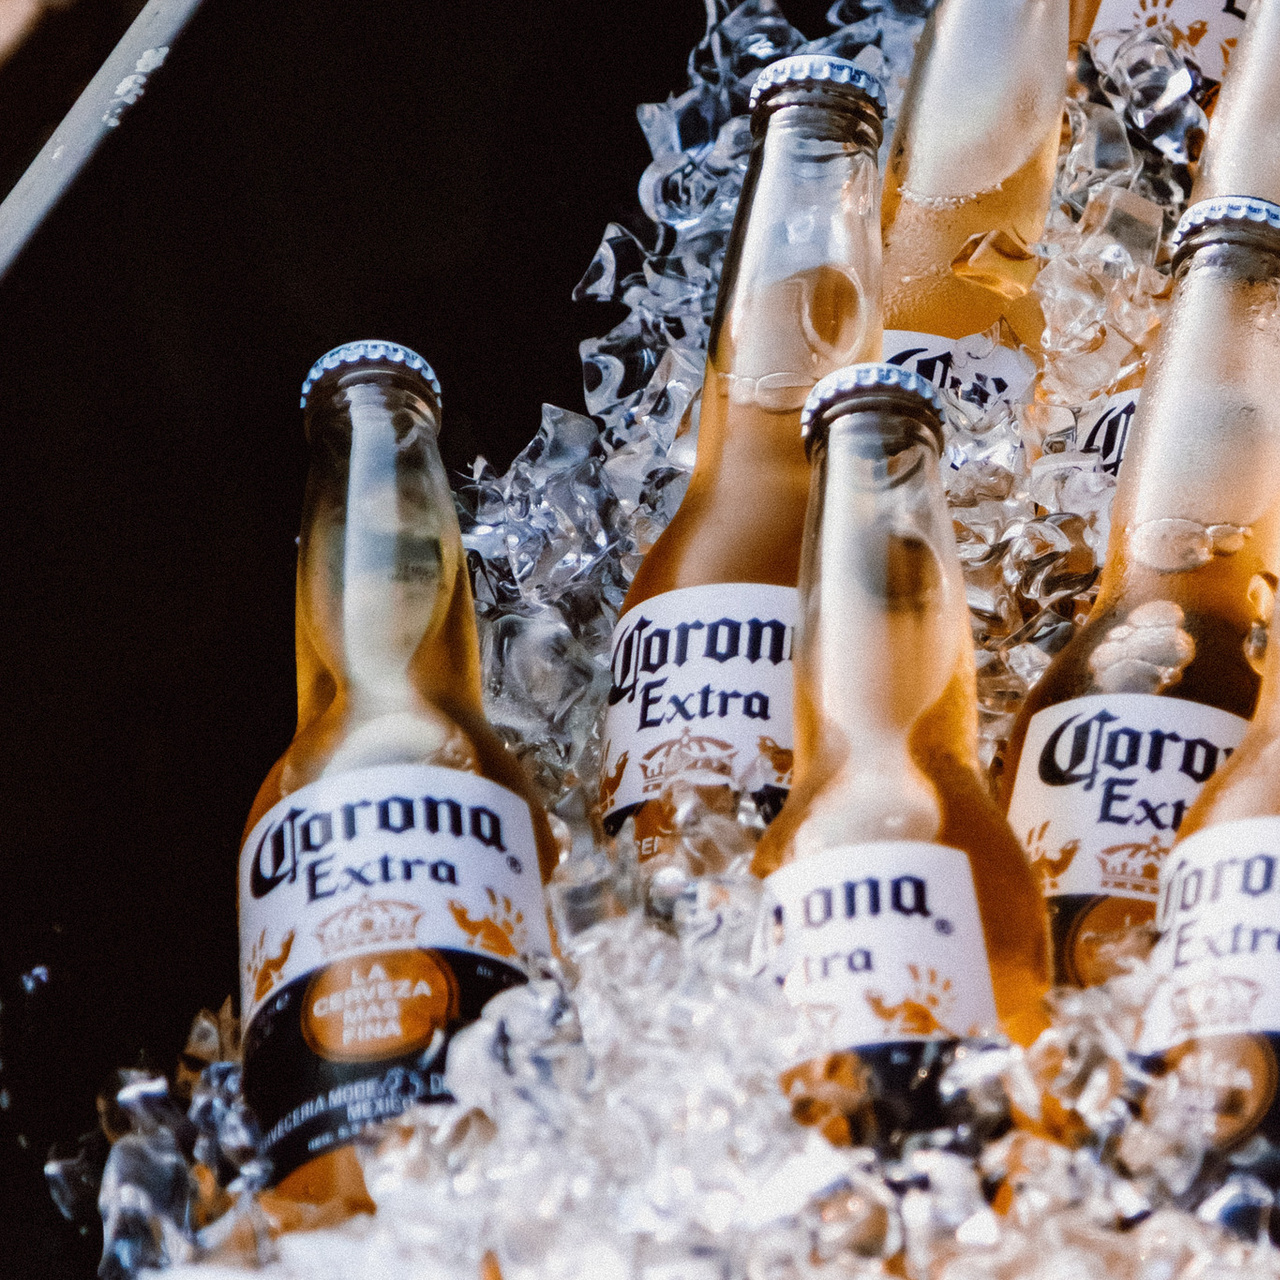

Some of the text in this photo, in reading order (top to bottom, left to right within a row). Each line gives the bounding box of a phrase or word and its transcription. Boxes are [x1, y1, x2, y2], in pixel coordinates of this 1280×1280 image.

[608, 615, 794, 707] Coron
[637, 676, 772, 733] Extra
[1038, 708, 1235, 792] Coro
[1097, 776, 1188, 833] Ext
[249, 794, 508, 900] Corona
[306, 853, 460, 904] Extra
[312, 978, 432, 1018] CERVEZA
[350, 963, 388, 988] LA
